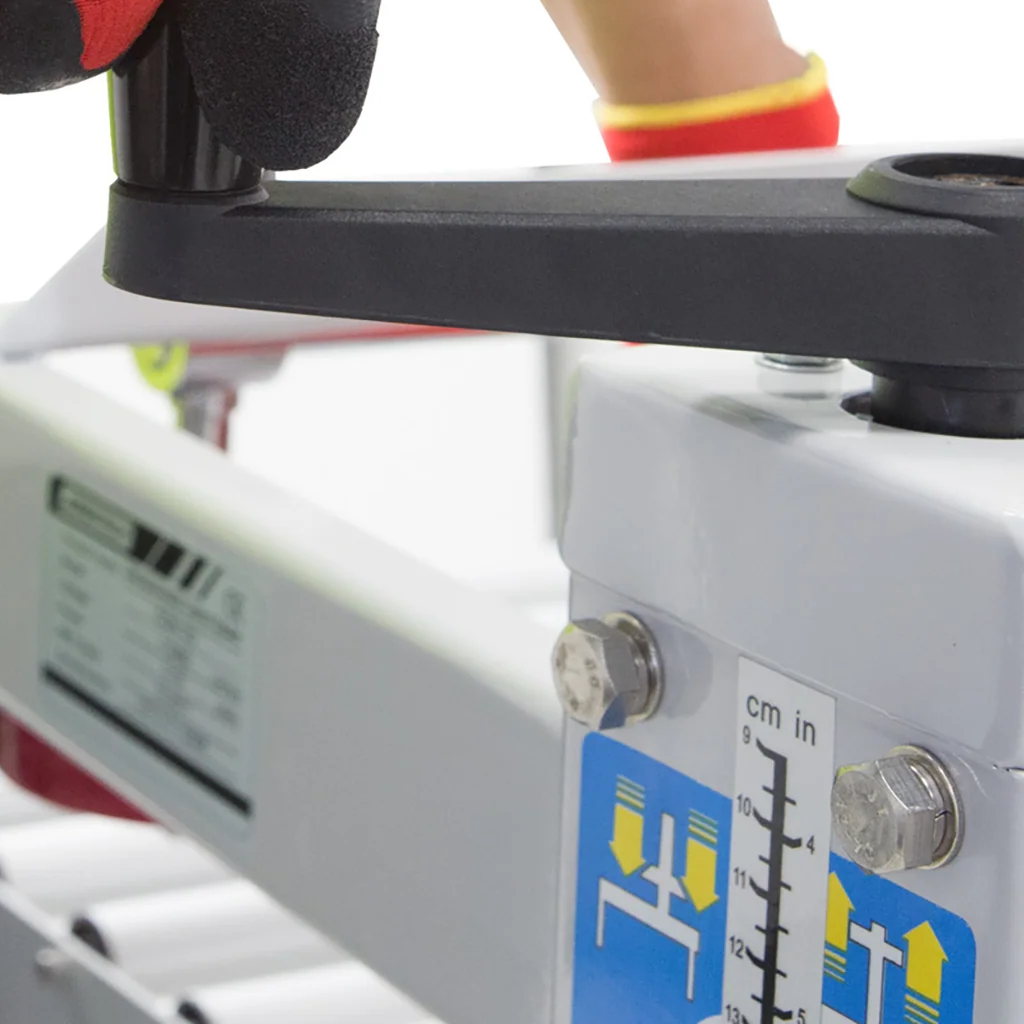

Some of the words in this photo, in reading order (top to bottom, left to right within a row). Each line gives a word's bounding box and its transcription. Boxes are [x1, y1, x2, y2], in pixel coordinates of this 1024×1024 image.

[746, 694, 781, 729] cm
[795, 709, 816, 747] in
[742, 725, 751, 744] 9
[736, 793, 752, 817] 10
[806, 835, 815, 855] 4
[733, 866, 747, 889] 11
[729, 935, 744, 960] 12
